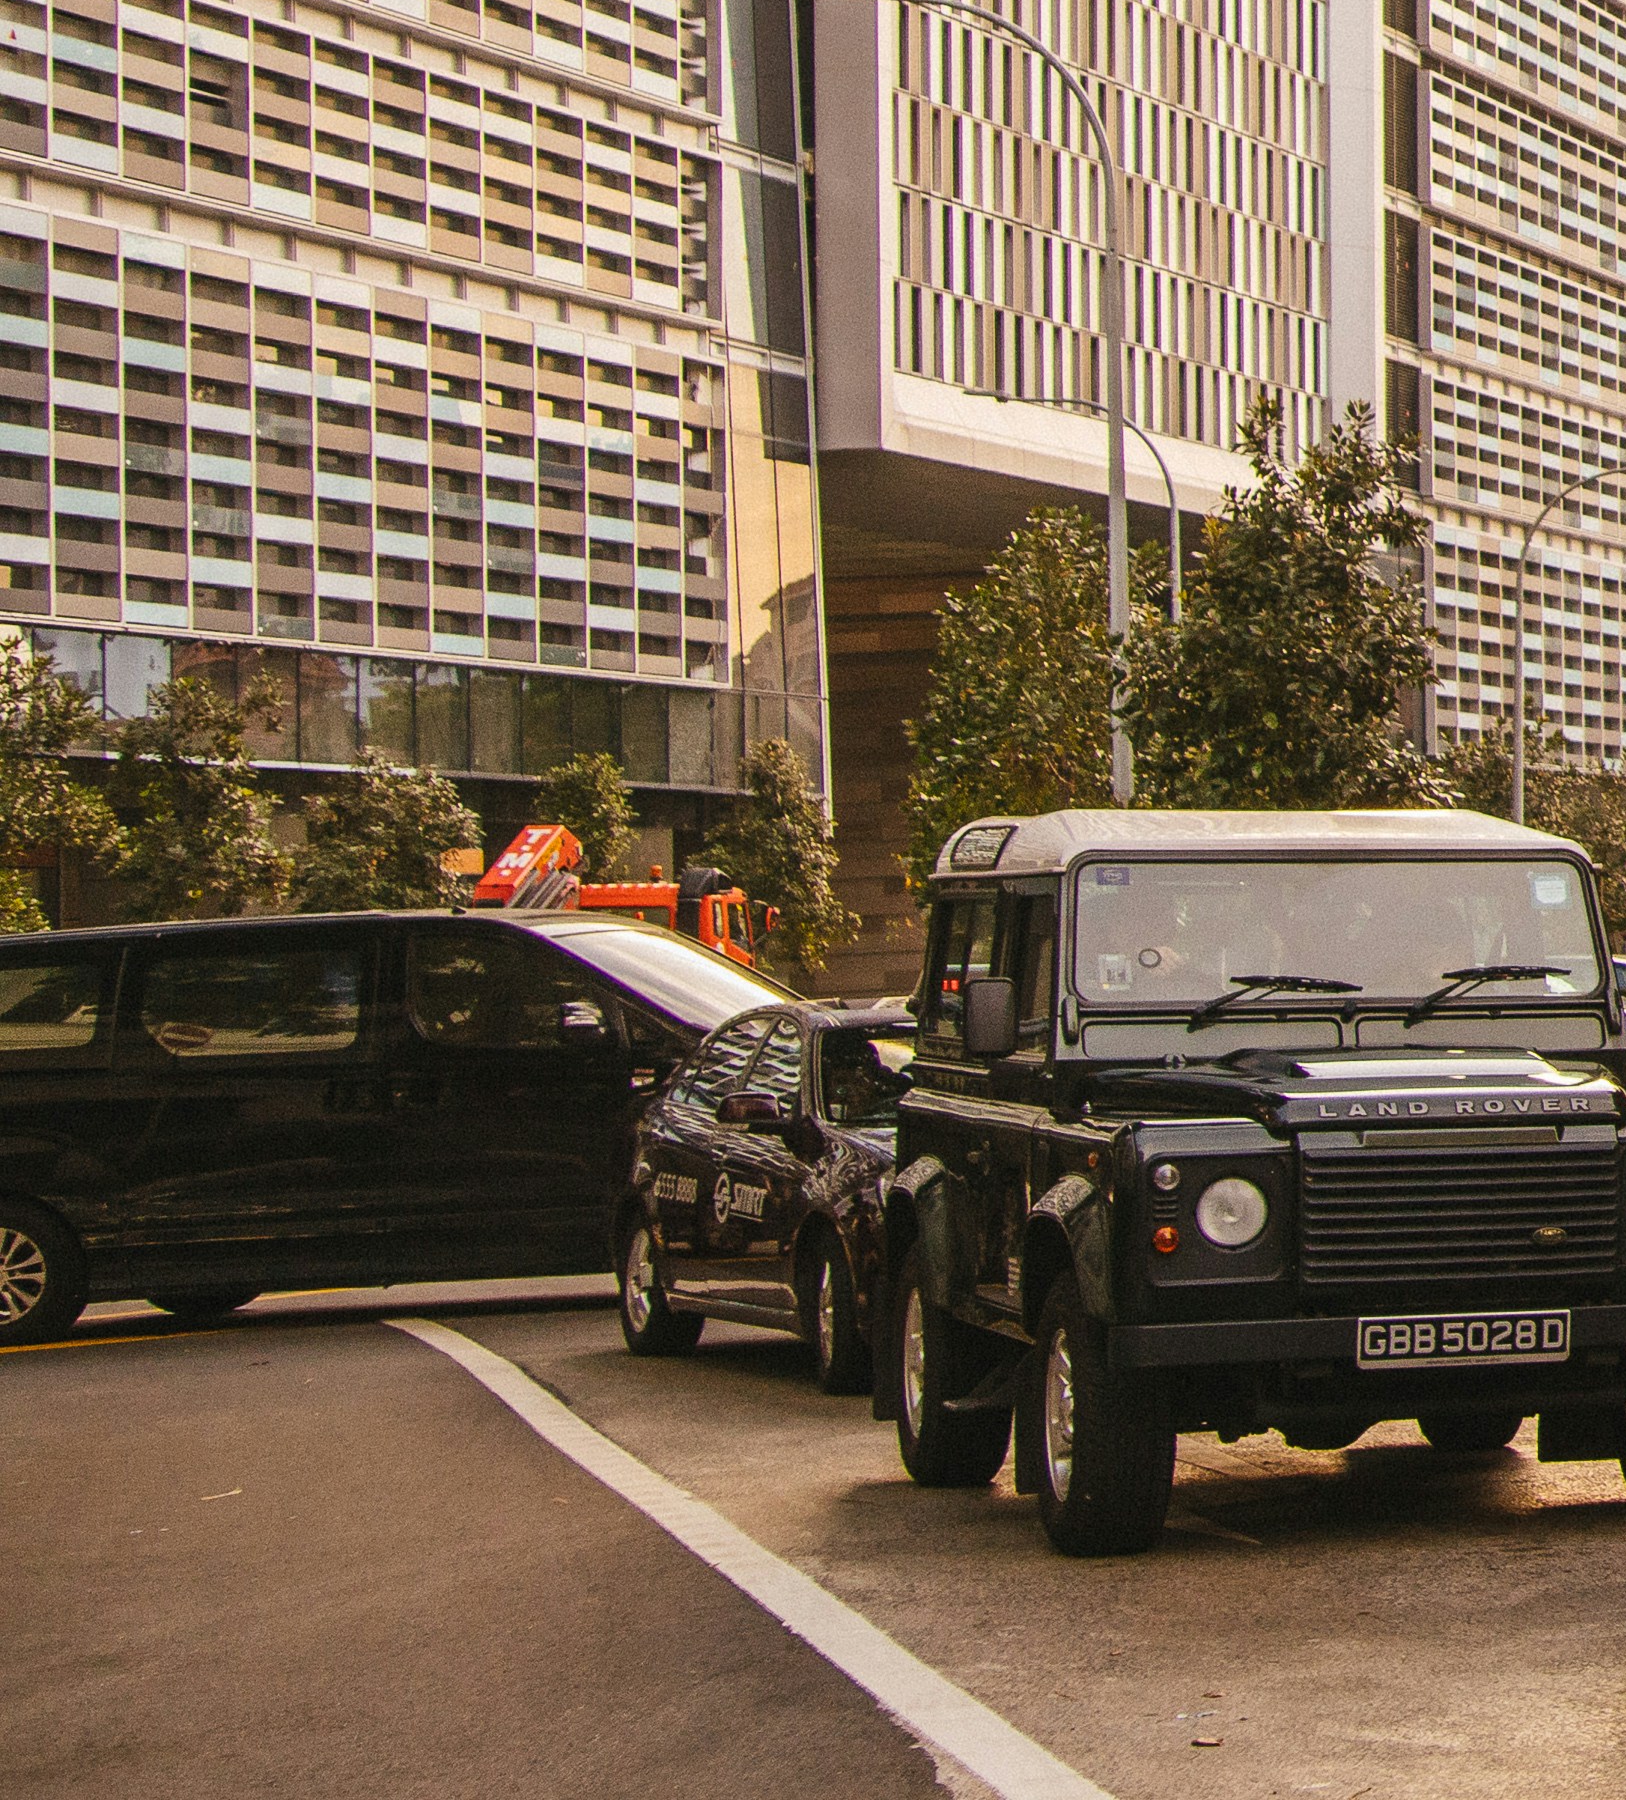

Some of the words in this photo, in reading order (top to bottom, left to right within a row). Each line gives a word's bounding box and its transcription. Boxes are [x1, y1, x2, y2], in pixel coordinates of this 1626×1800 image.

[1317, 1101, 1430, 1119] LAND
[1455, 1096, 1593, 1115] ROVER
[1363, 1317, 1565, 1356] GBB5028D
